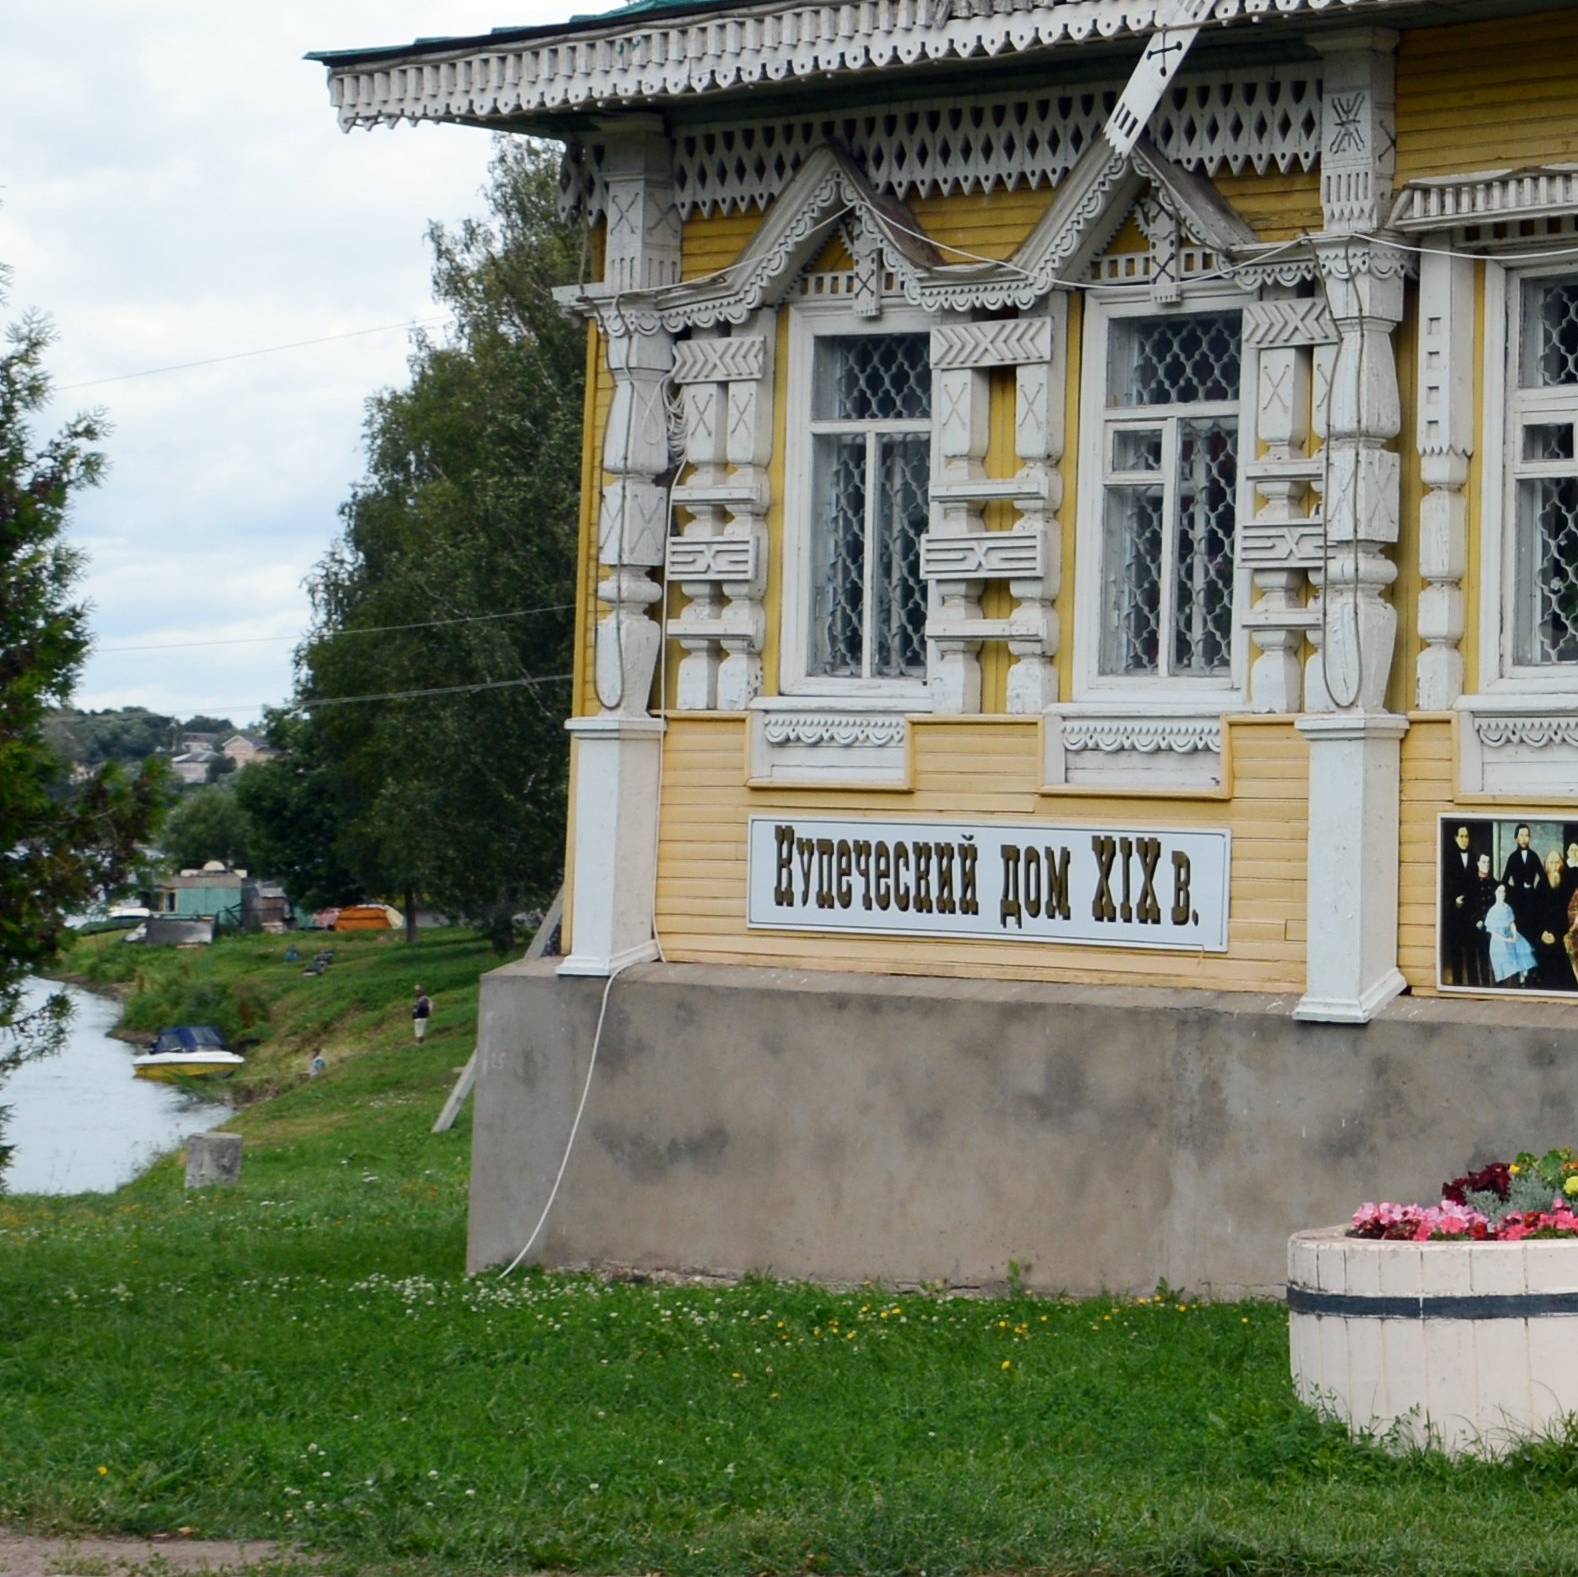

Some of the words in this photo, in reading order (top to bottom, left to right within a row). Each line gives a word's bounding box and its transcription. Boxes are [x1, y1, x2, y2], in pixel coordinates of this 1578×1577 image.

[775, 825, 978, 916] Купеческий
[1001, 841, 1071, 930] дом
[1092, 834, 1162, 925] XIX
